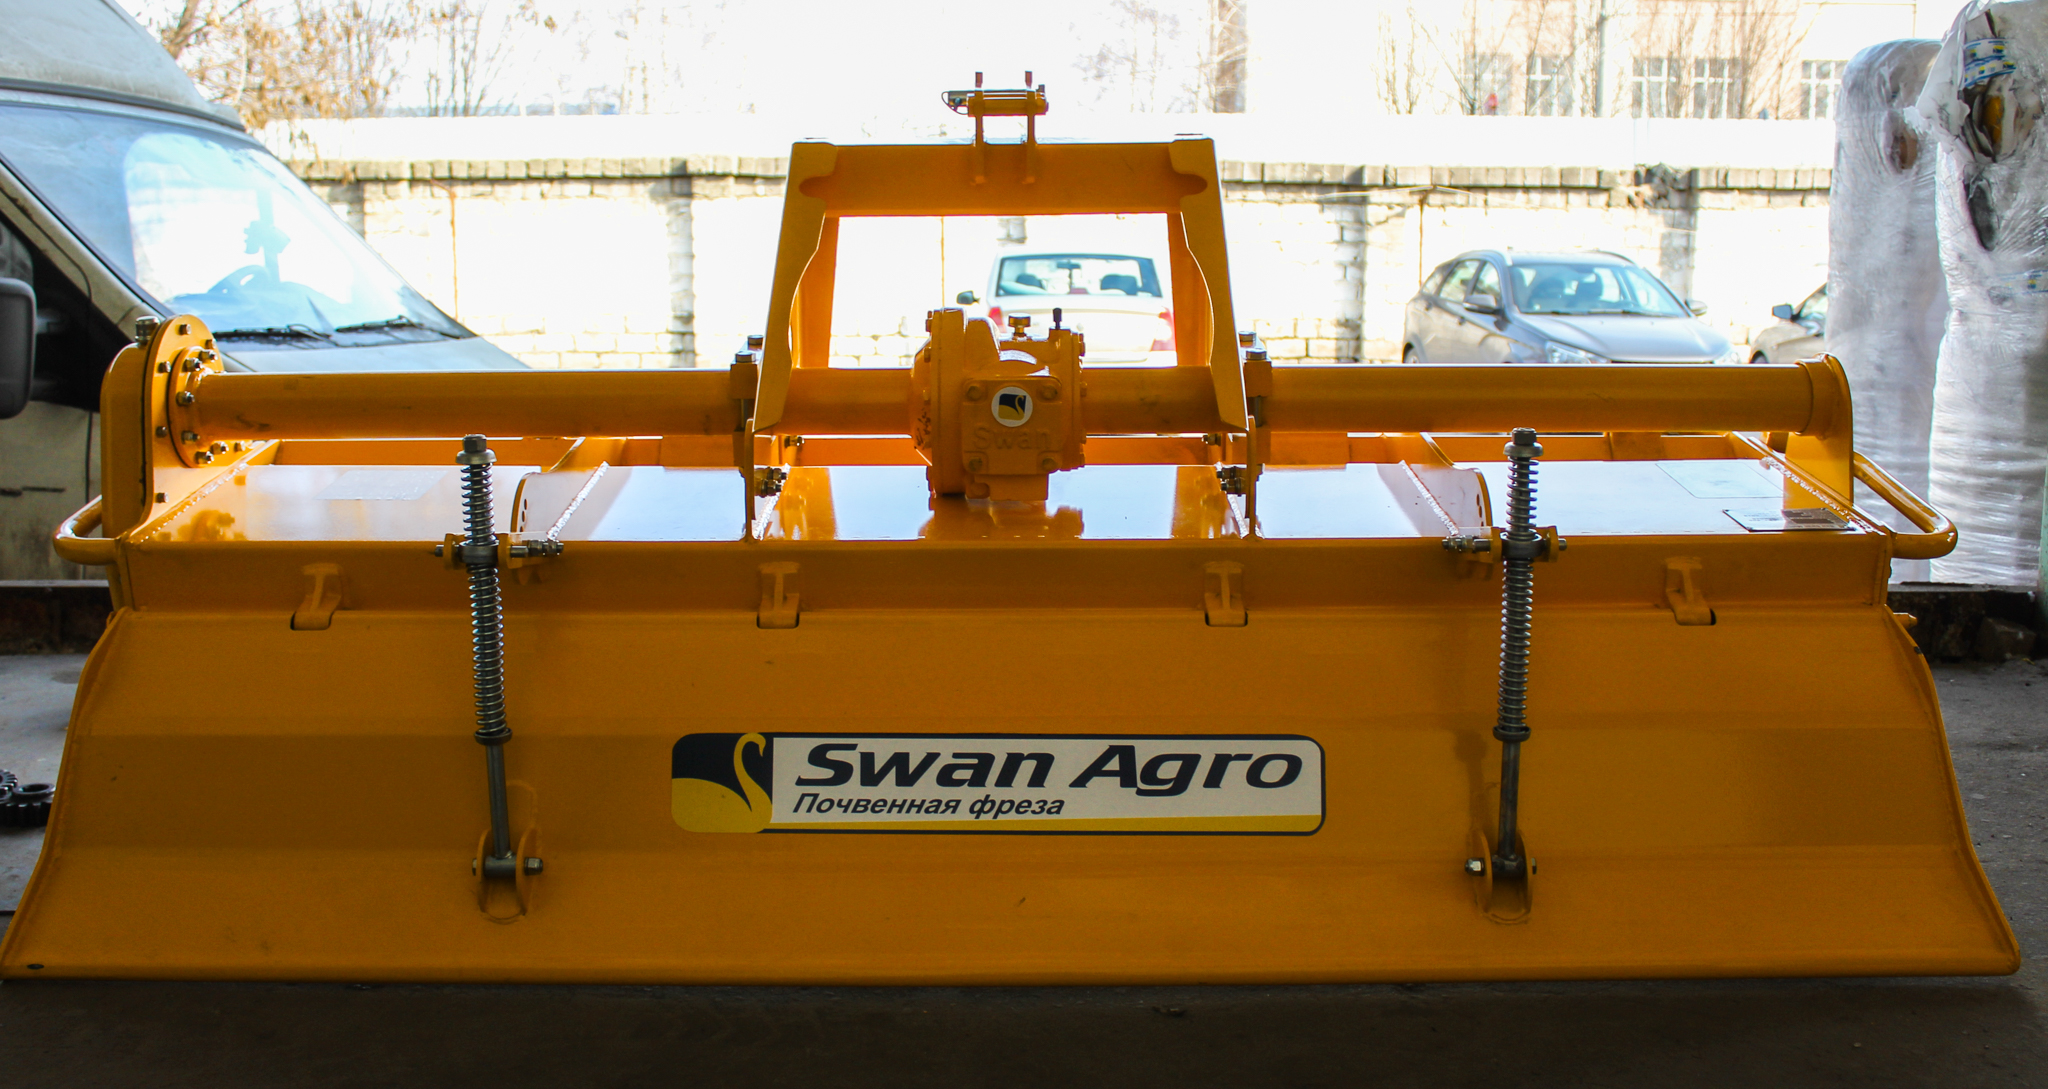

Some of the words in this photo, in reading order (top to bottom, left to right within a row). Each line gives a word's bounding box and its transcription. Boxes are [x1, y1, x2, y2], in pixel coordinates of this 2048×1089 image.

[974, 427, 1051, 450] Swan
[795, 743, 1055, 787] Swan
[1069, 744, 1303, 797] Agro
[792, 793, 962, 814] Почвенная
[969, 794, 1065, 820] фреза
